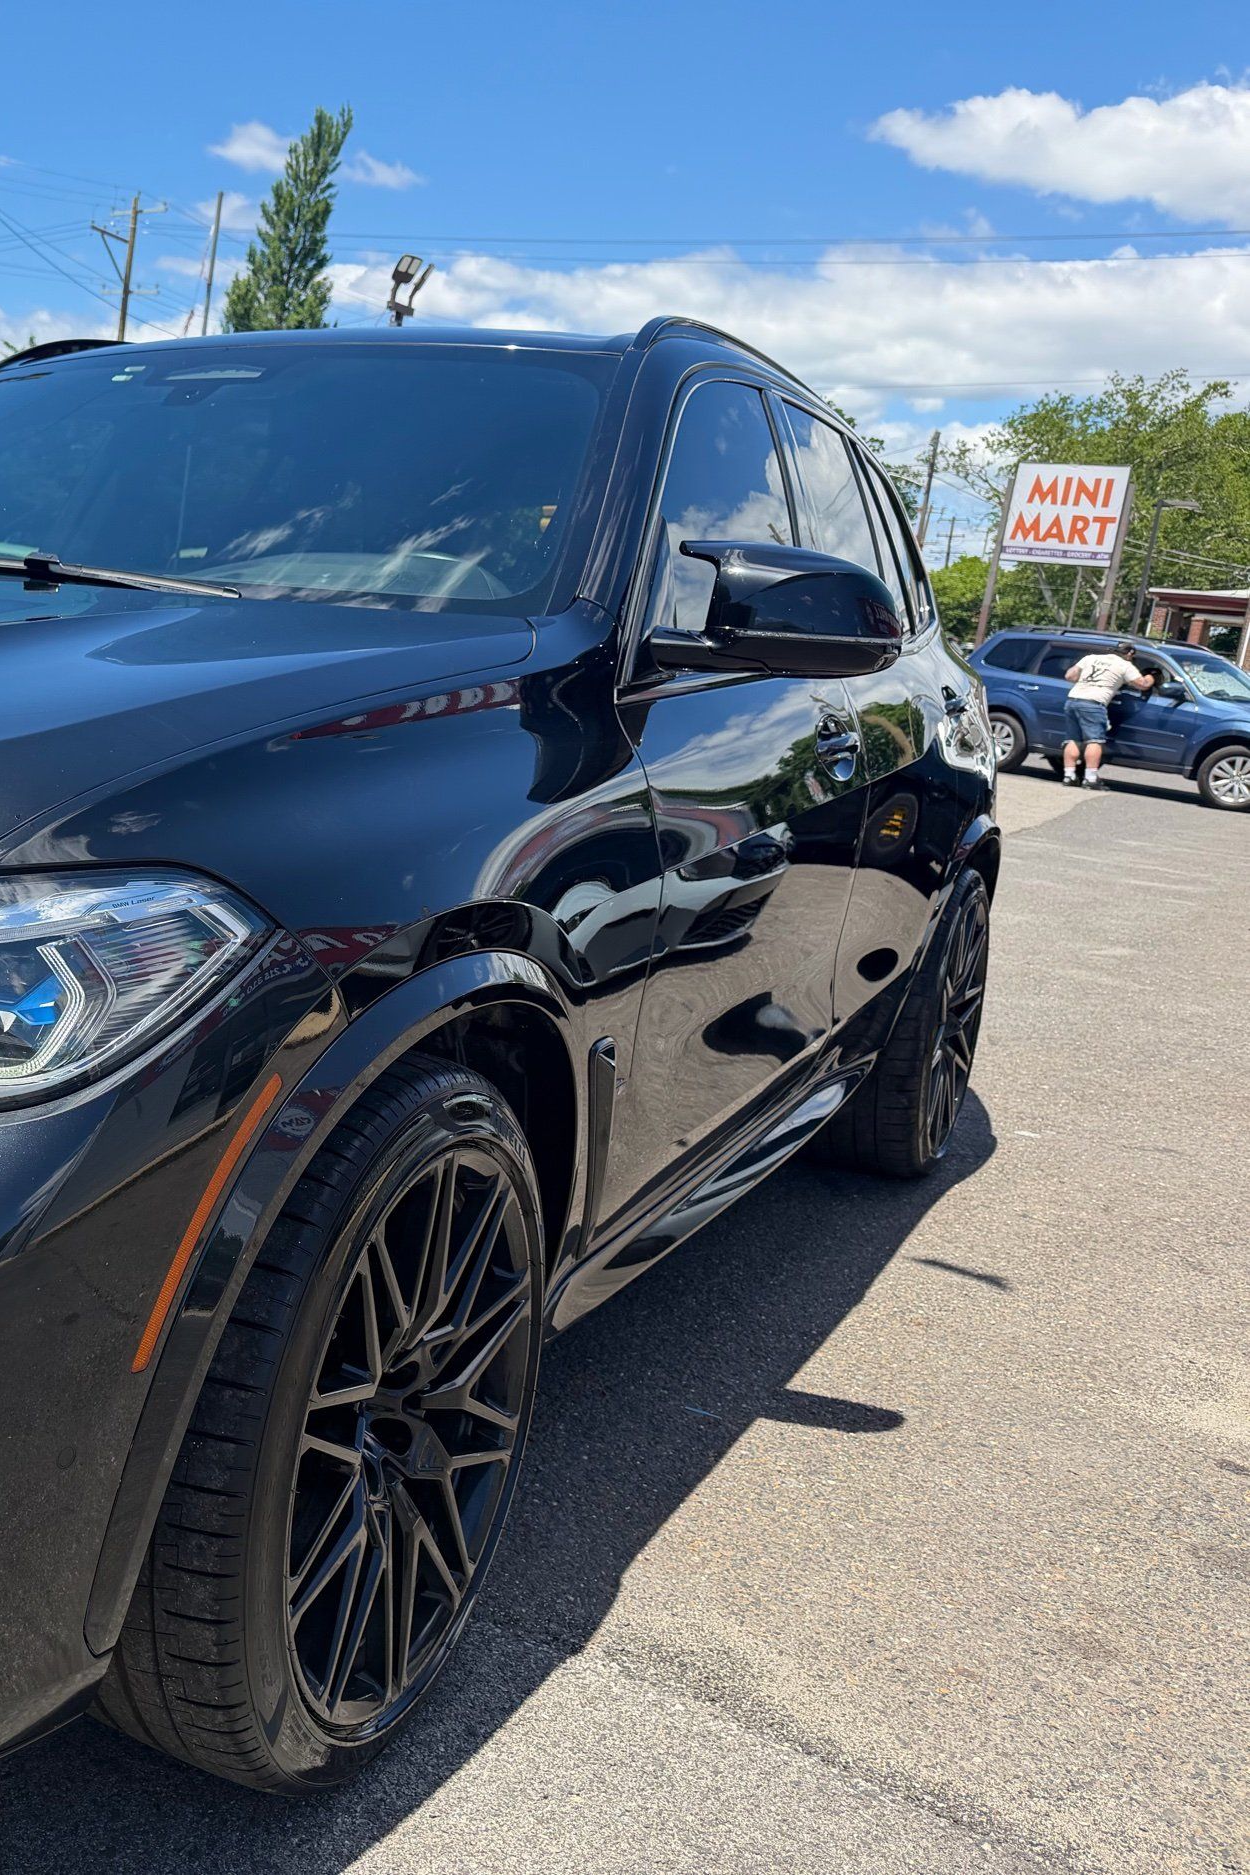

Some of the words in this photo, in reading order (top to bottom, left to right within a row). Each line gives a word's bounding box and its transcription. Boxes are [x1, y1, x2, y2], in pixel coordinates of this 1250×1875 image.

[1026, 473, 1116, 509] MINI
[1009, 510, 1118, 546] MART
[111, 901, 130, 909] BMW
[131, 896, 155, 905] Laser
